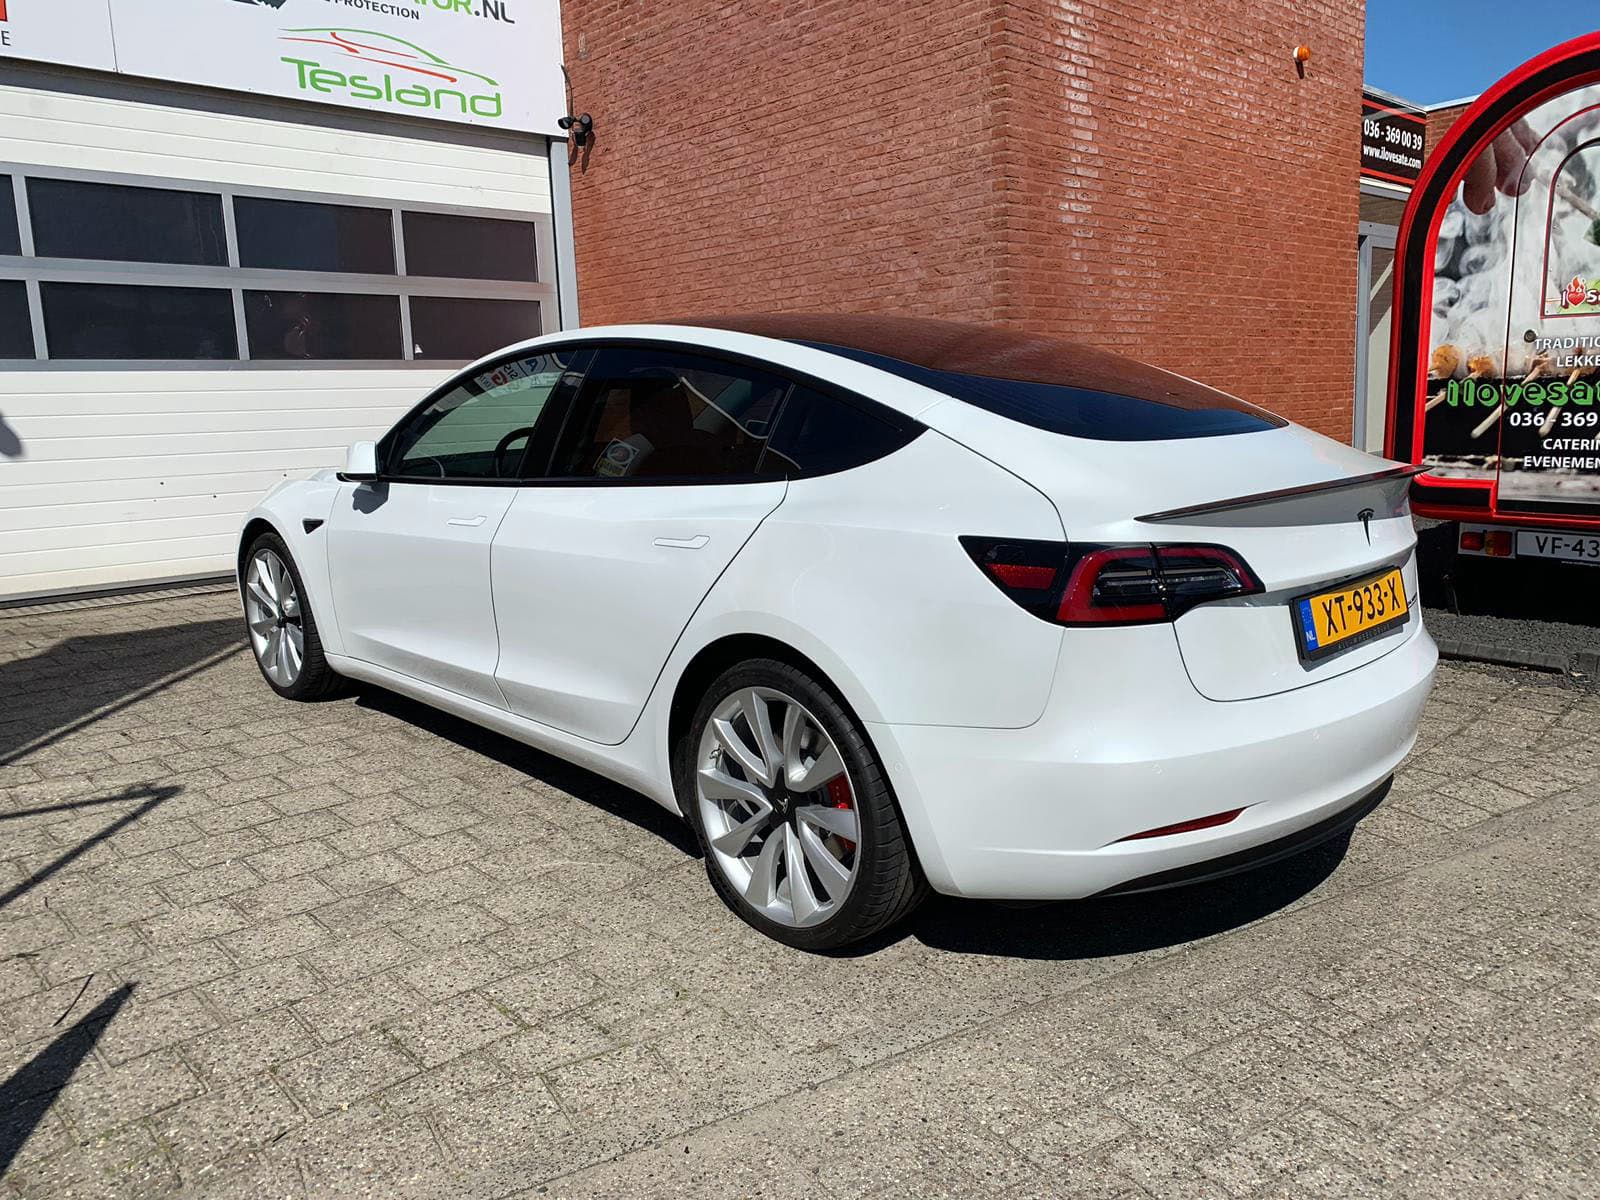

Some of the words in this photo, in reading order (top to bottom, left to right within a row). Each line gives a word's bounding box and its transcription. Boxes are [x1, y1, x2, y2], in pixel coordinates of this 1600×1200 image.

[281, 56, 502, 117] Tesland
[1364, 119, 1380, 139] 036
[1385, 125, 1400, 145] 369
[1401, 130, 1412, 148] 00
[1412, 133, 1423, 151] 39
[1363, 144, 1422, 170] www.ilovesate.com
[1510, 412, 1544, 427] 036
[1561, 412, 1598, 427] 369
[1535, 535, 1600, 558] VF-43
[1322, 577, 1401, 636] XT-933-X
[1306, 630, 1316, 642] NL
